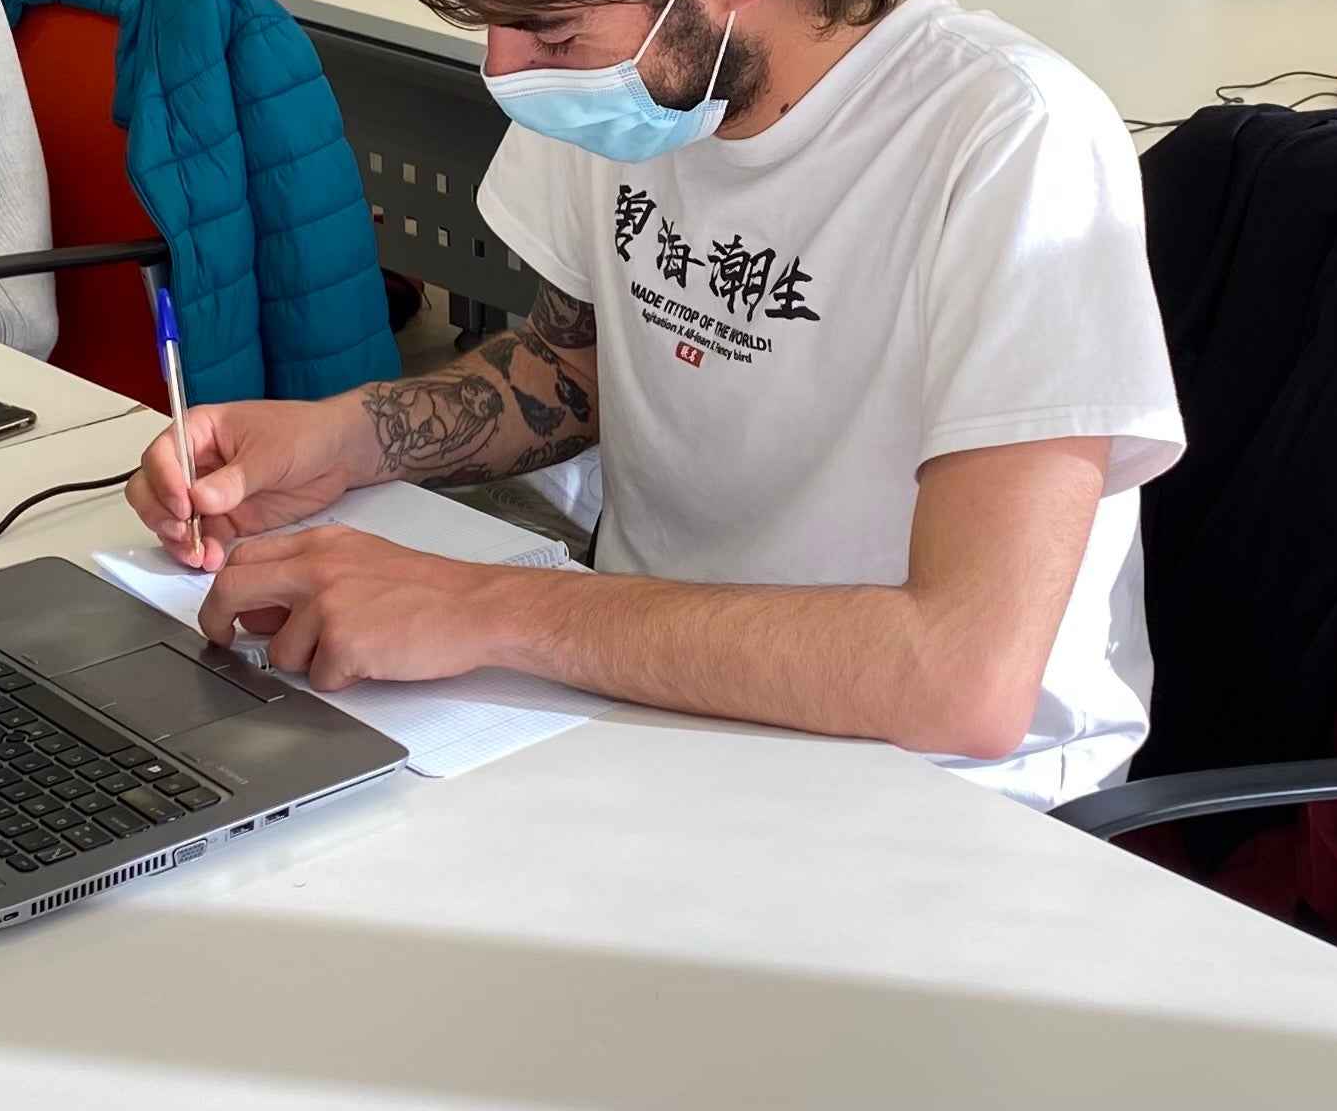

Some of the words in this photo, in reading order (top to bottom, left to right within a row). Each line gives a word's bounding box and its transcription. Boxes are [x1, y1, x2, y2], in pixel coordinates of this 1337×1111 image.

[631, 281, 664, 308] MADE
[699, 314, 715, 331] OF
[714, 321, 730, 339] THE
[733, 349, 752, 363] bird
